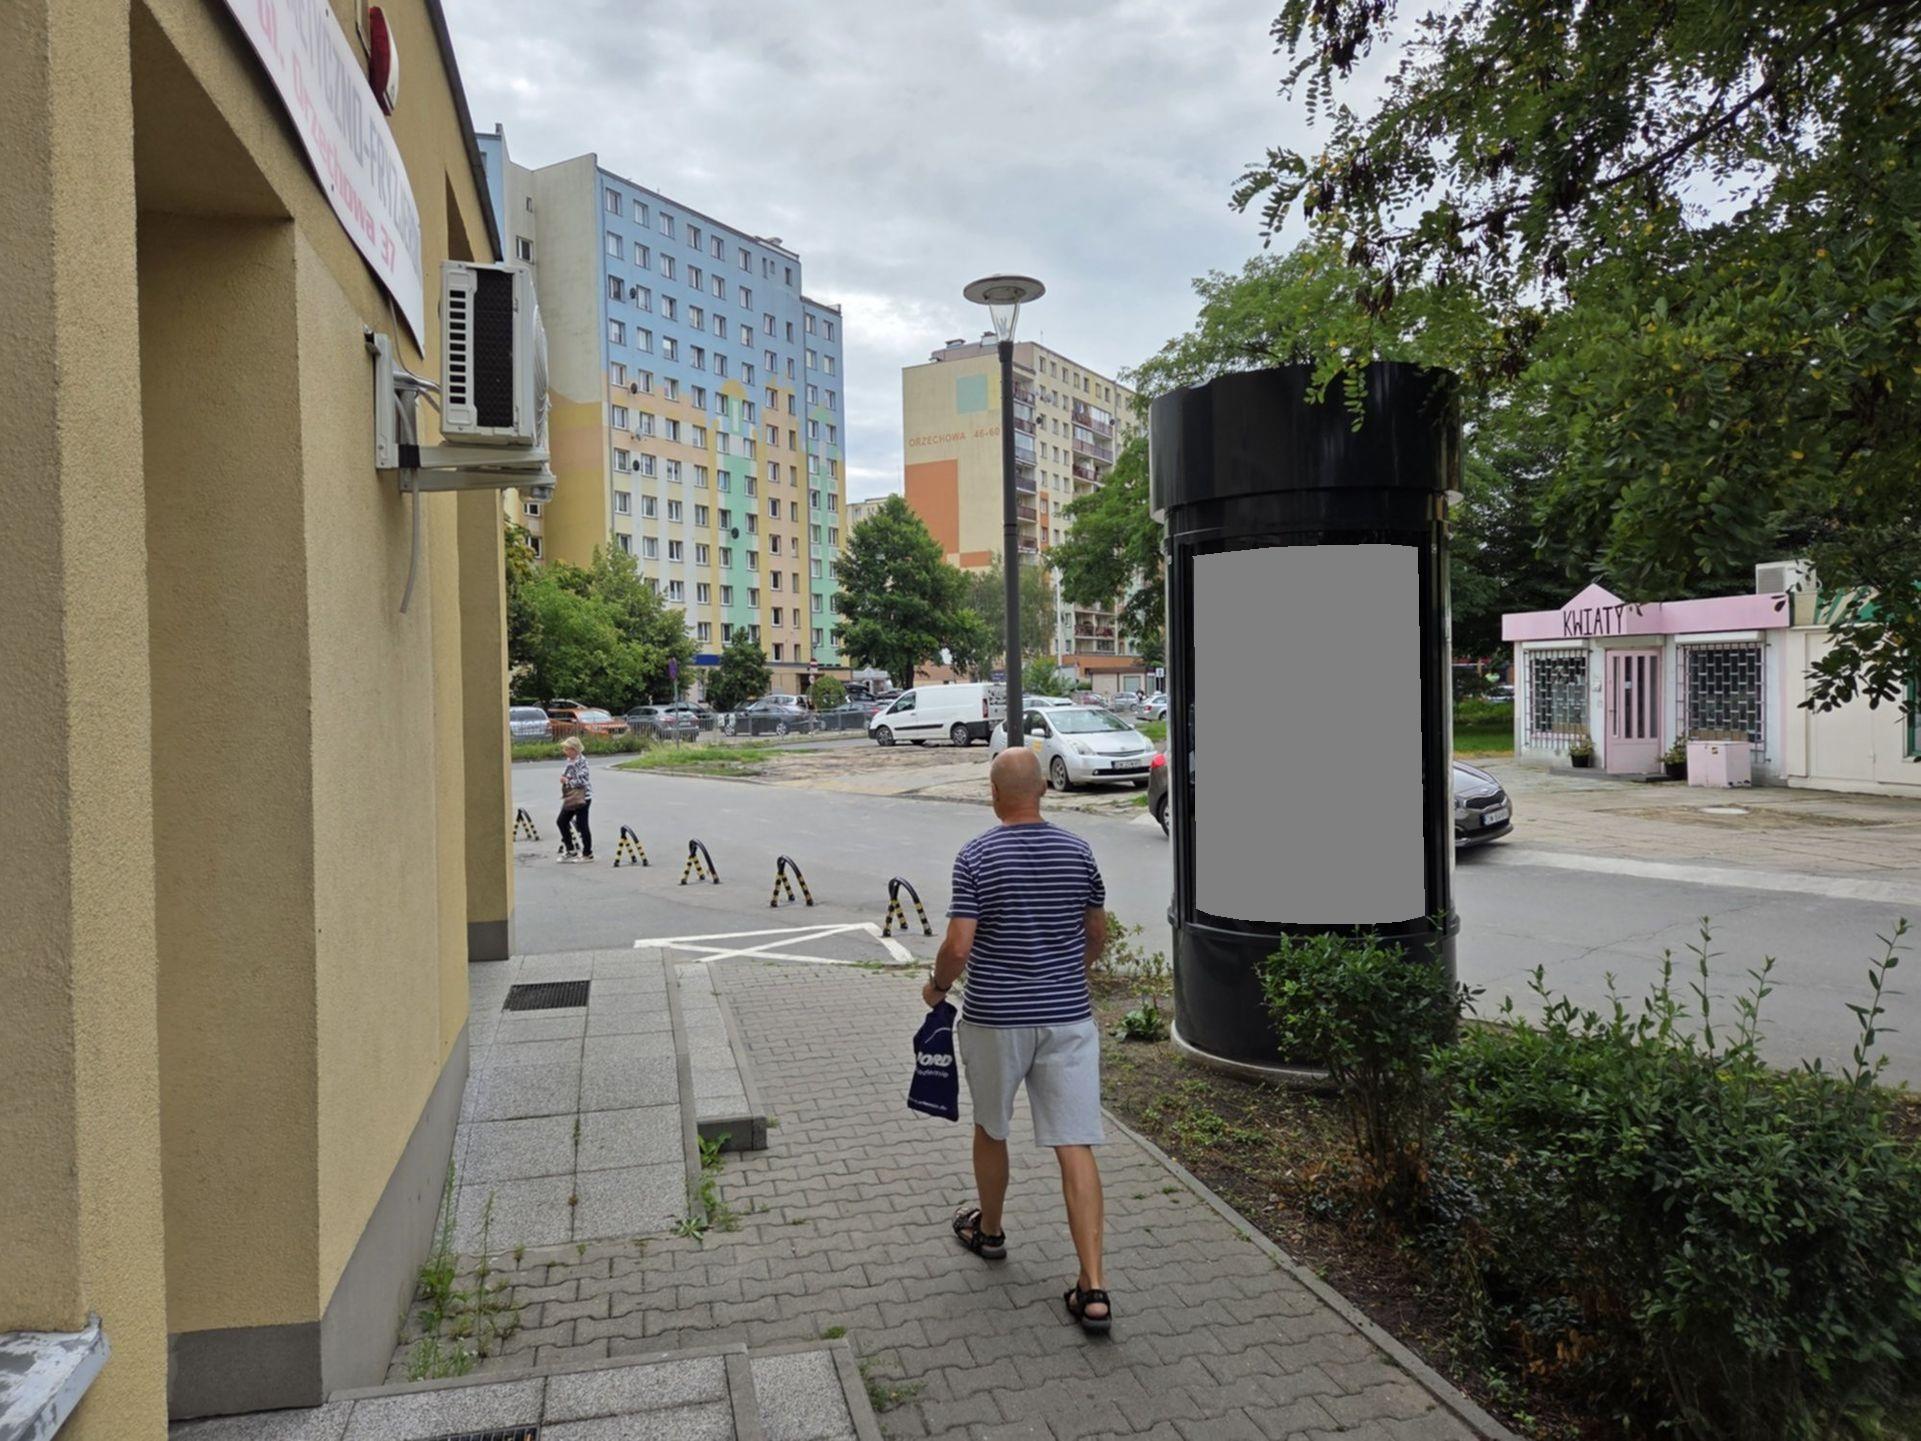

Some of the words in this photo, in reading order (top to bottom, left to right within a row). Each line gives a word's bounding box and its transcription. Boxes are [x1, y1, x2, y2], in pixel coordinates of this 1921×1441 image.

[292, 50, 376, 247] Orzechowa
[380, 222, 396, 274] 37
[909, 432, 965, 447] ORZECHOWA
[1563, 604, 1625, 637] KWIATY
